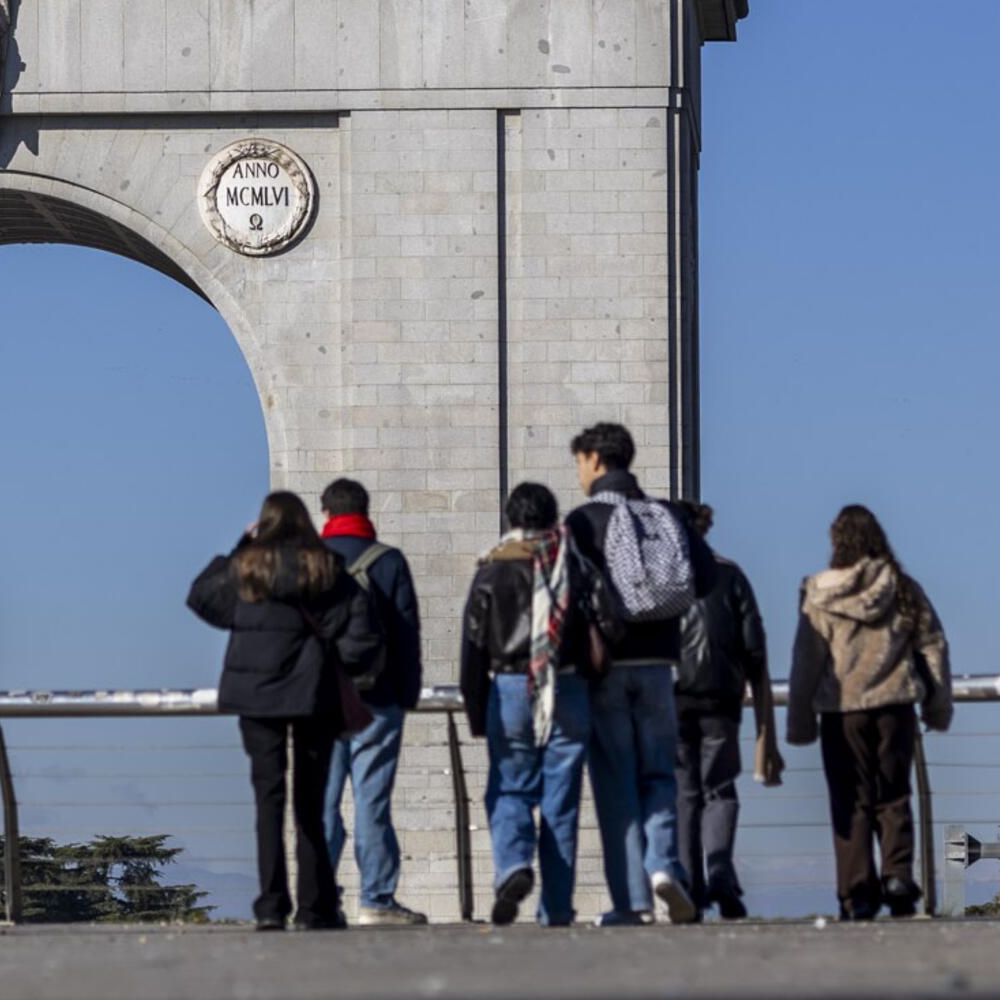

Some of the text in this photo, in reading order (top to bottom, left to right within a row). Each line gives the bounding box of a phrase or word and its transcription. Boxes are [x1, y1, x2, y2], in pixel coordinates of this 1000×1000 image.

[232, 162, 279, 179] ANNO
[226, 186, 289, 207] MCMLVI
[249, 212, 263, 231] Ω
